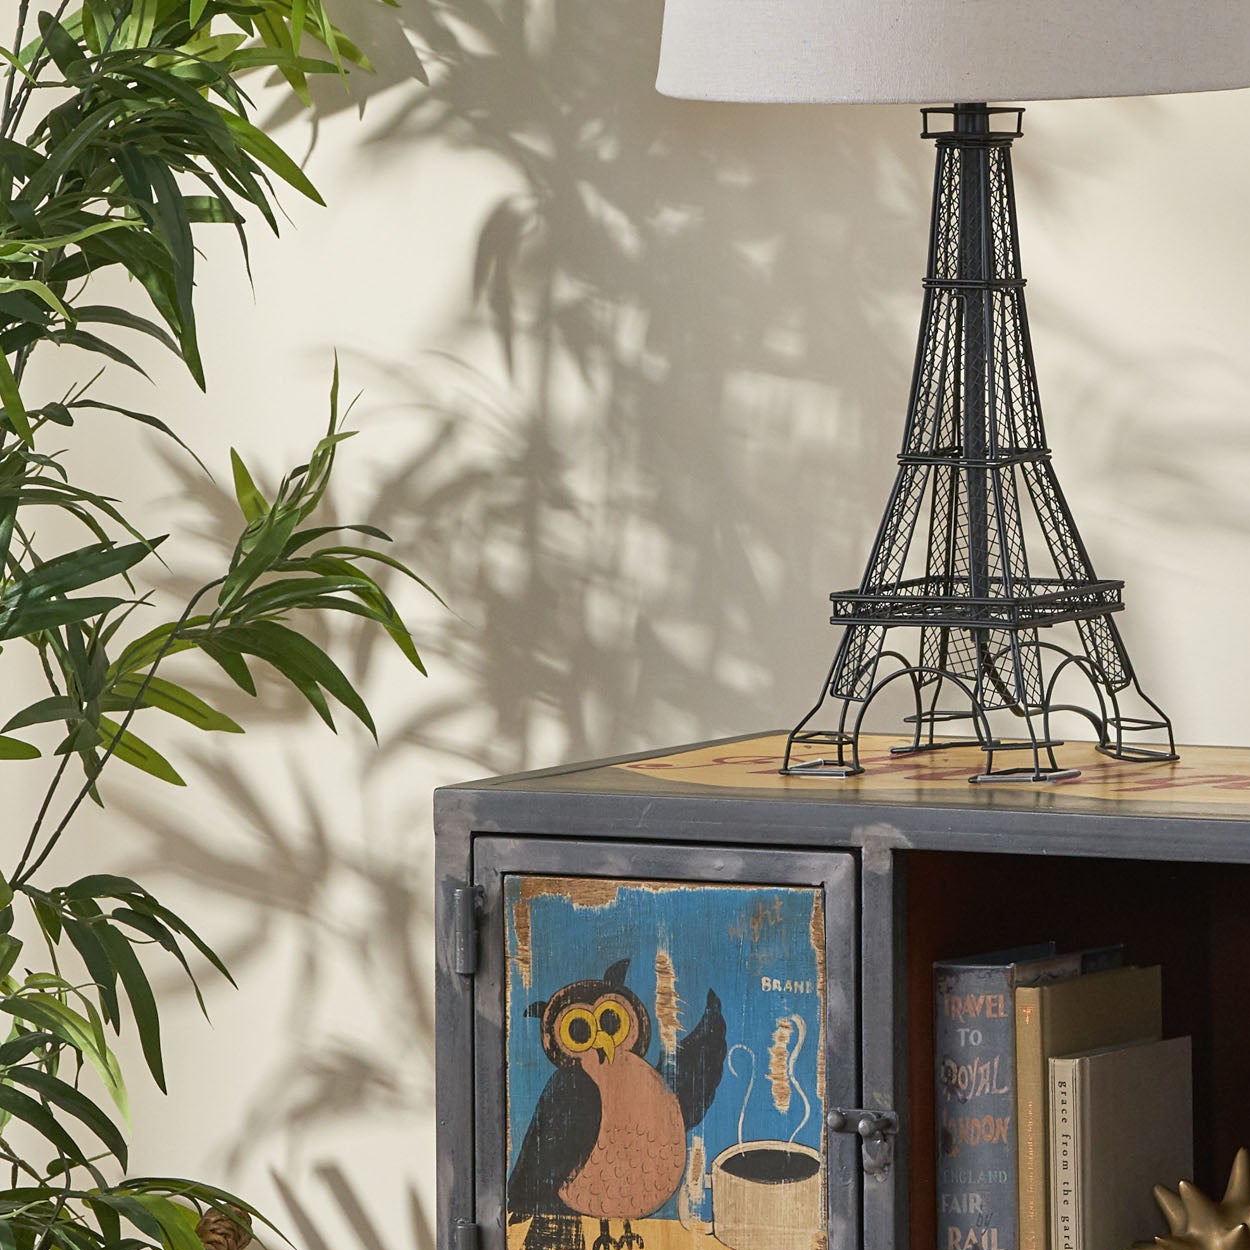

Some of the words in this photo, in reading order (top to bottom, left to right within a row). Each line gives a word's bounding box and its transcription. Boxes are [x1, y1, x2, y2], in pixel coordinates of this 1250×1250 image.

[943, 993, 1008, 1022] TRAVEL
[956, 1028, 983, 1047] TO
[940, 1056, 1008, 1101] ROYAL
[1058, 1081, 1067, 1123] grace
[1062, 1134, 1071, 1170] from
[941, 1192, 983, 1214] FAIR
[1063, 1181, 1072, 1206] the
